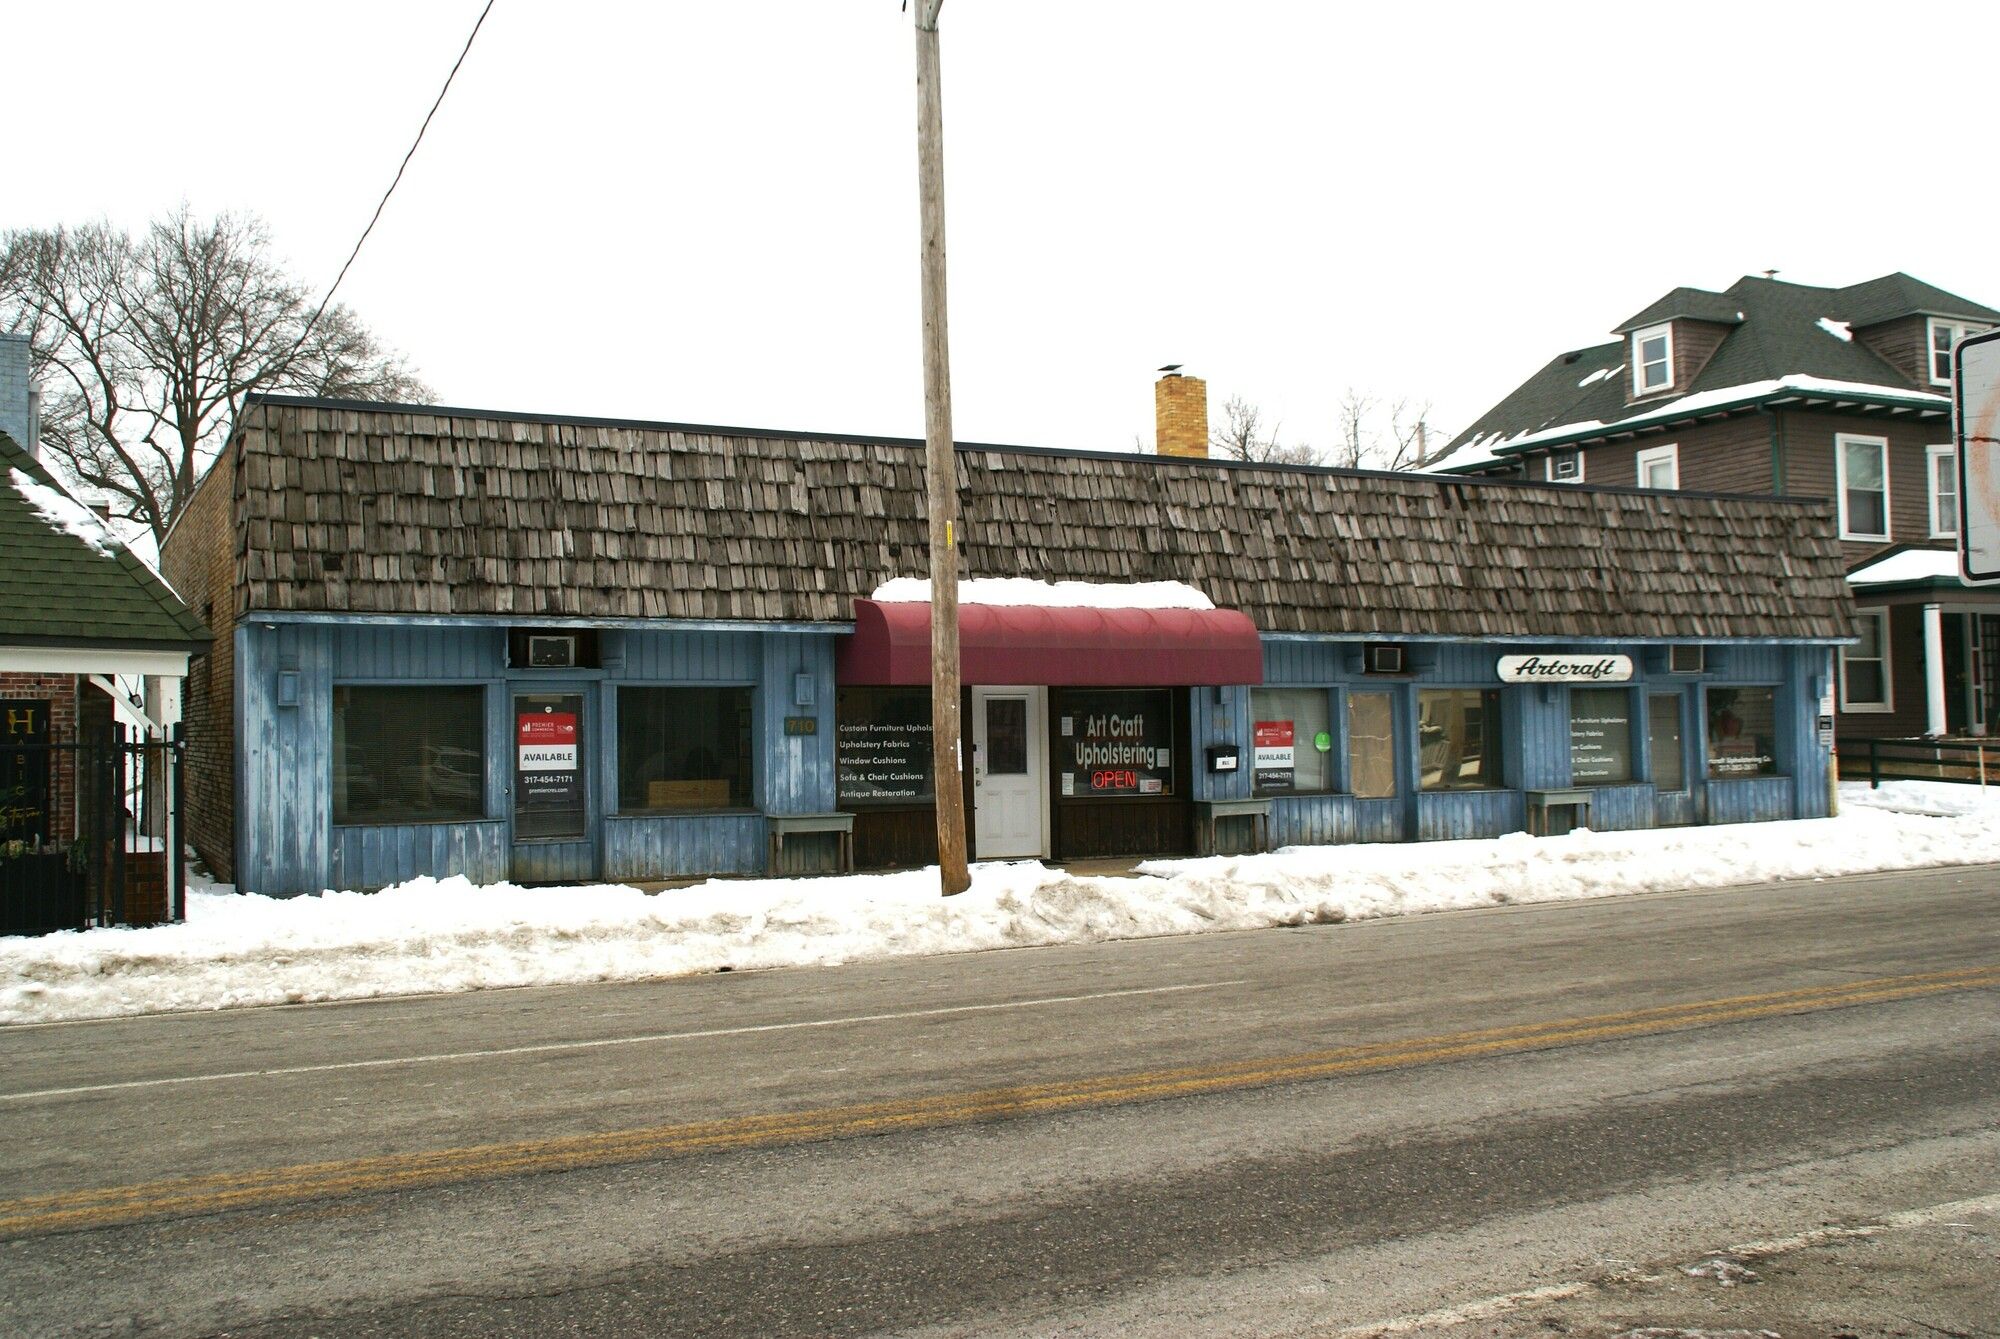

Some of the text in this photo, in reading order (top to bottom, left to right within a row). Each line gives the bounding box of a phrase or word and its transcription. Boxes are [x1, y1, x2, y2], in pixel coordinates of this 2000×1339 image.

[1515, 656, 1616, 679] Artcraft
[788, 720, 815, 733] 710
[840, 724, 934, 733] Custom Furniture Uphols
[1087, 714, 1107, 737] Art
[1110, 714, 1144, 737] Craft
[840, 741, 881, 749] Upholstery
[523, 753, 573, 761] AVAILABLE
[1075, 742, 1155, 770] Upholstering
[1257, 753, 1292, 761] AVAILABLE
[524, 775, 573, 783] 317-454-7171
[867, 773, 888, 781] Chair
[1093, 770, 1136, 788] OPEN
[840, 789, 916, 799] Antique Restoration
